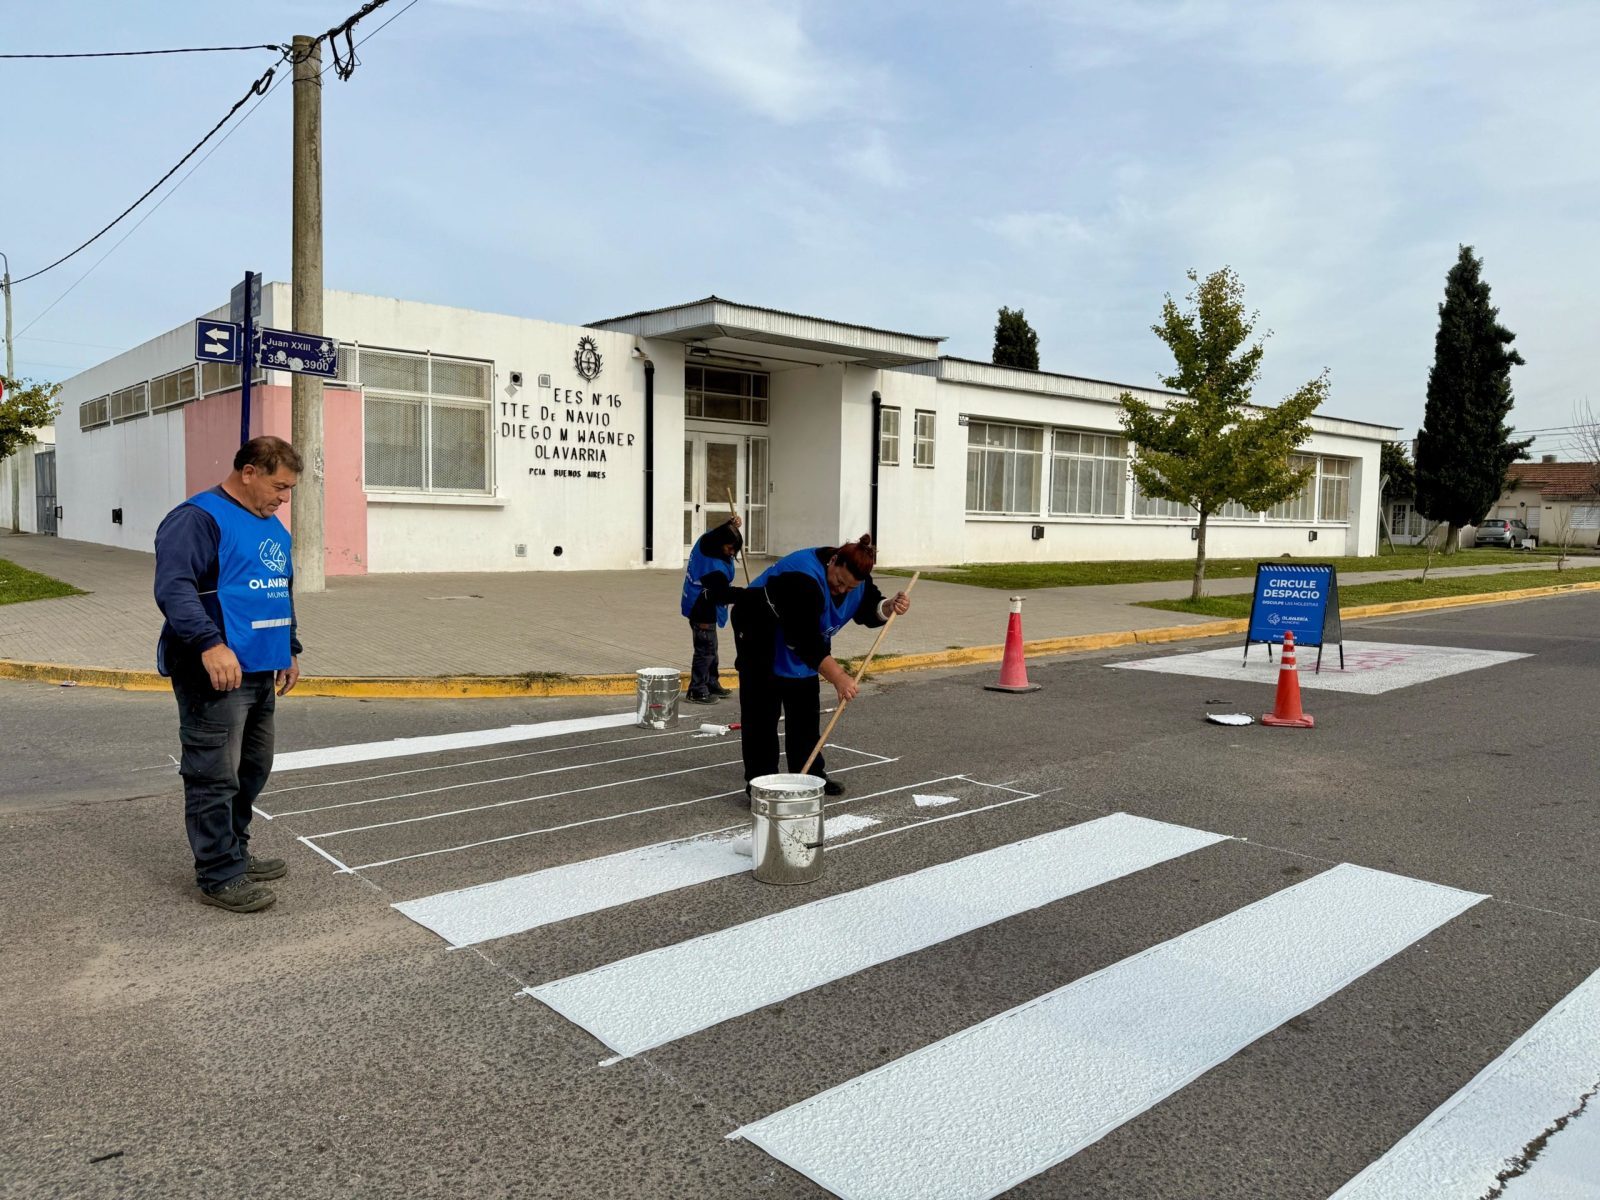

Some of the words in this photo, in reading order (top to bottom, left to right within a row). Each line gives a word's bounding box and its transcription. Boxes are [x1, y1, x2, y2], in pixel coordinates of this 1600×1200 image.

[267, 339, 288, 347] Juan
[291, 342, 311, 351] XXIII
[304, 360, 328, 371] 3900
[554, 388, 583, 405] EES
[606, 394, 622, 408] 16
[500, 402, 530, 419] TTE
[566, 409, 610, 427] NAVIO
[501, 422, 552, 441] DIEGO
[560, 428, 568, 441] M
[578, 430, 635, 447] WAGNER
[535, 444, 607, 462] OLAVARRIA
[529, 467, 546, 476] PCIA
[553, 469, 581, 478] BUENOS
[587, 471, 606, 479] AIRES
[1269, 579, 1316, 588] CIRCULE
[1264, 589, 1319, 599] DESPACIO
